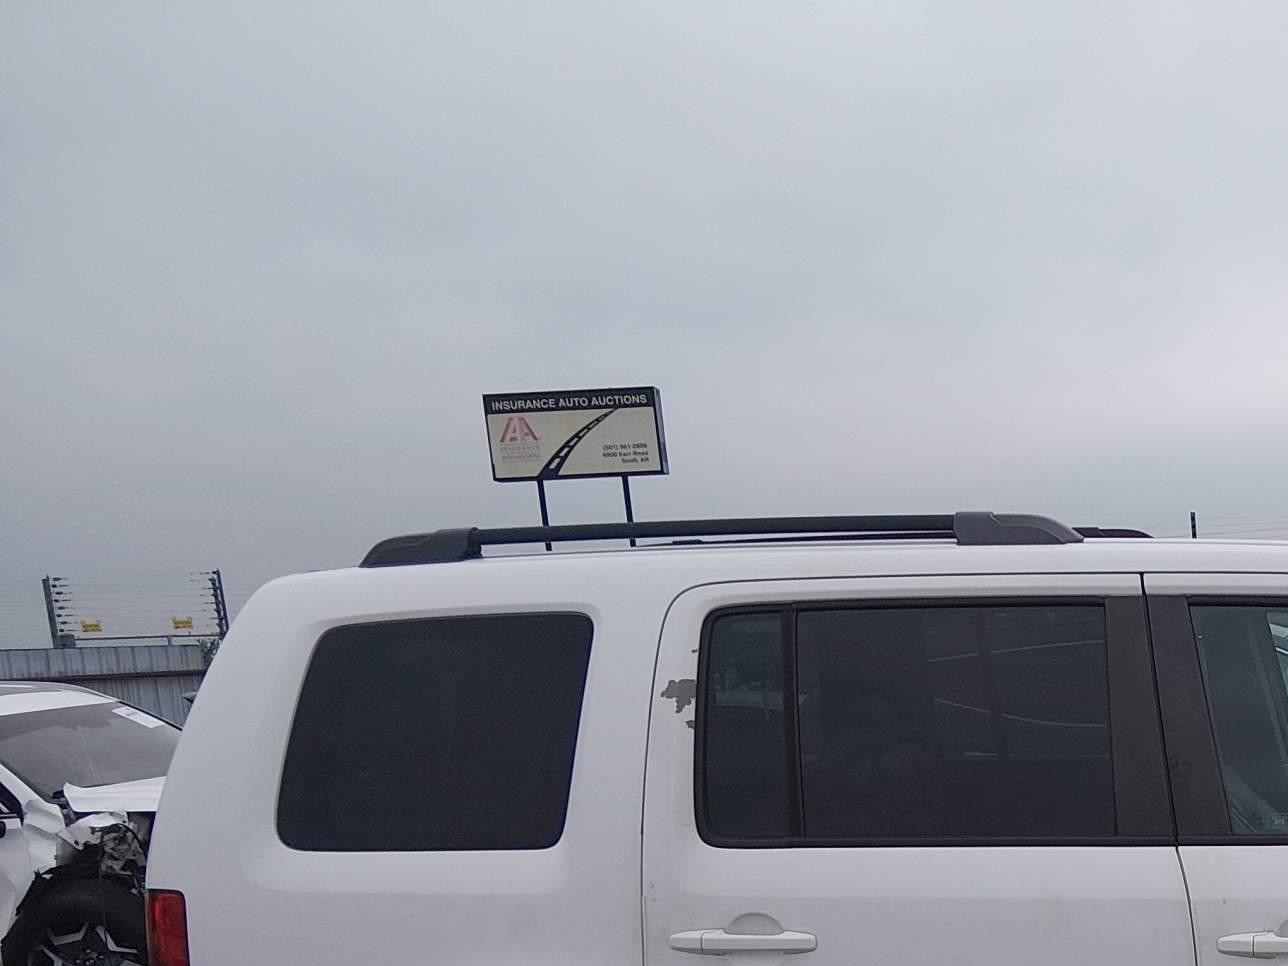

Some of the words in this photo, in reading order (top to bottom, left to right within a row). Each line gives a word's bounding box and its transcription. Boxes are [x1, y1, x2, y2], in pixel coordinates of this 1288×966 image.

[491, 398, 556, 411] INSURANCE
[558, 396, 589, 408] AUTO
[591, 394, 648, 406] AUCTIONS
